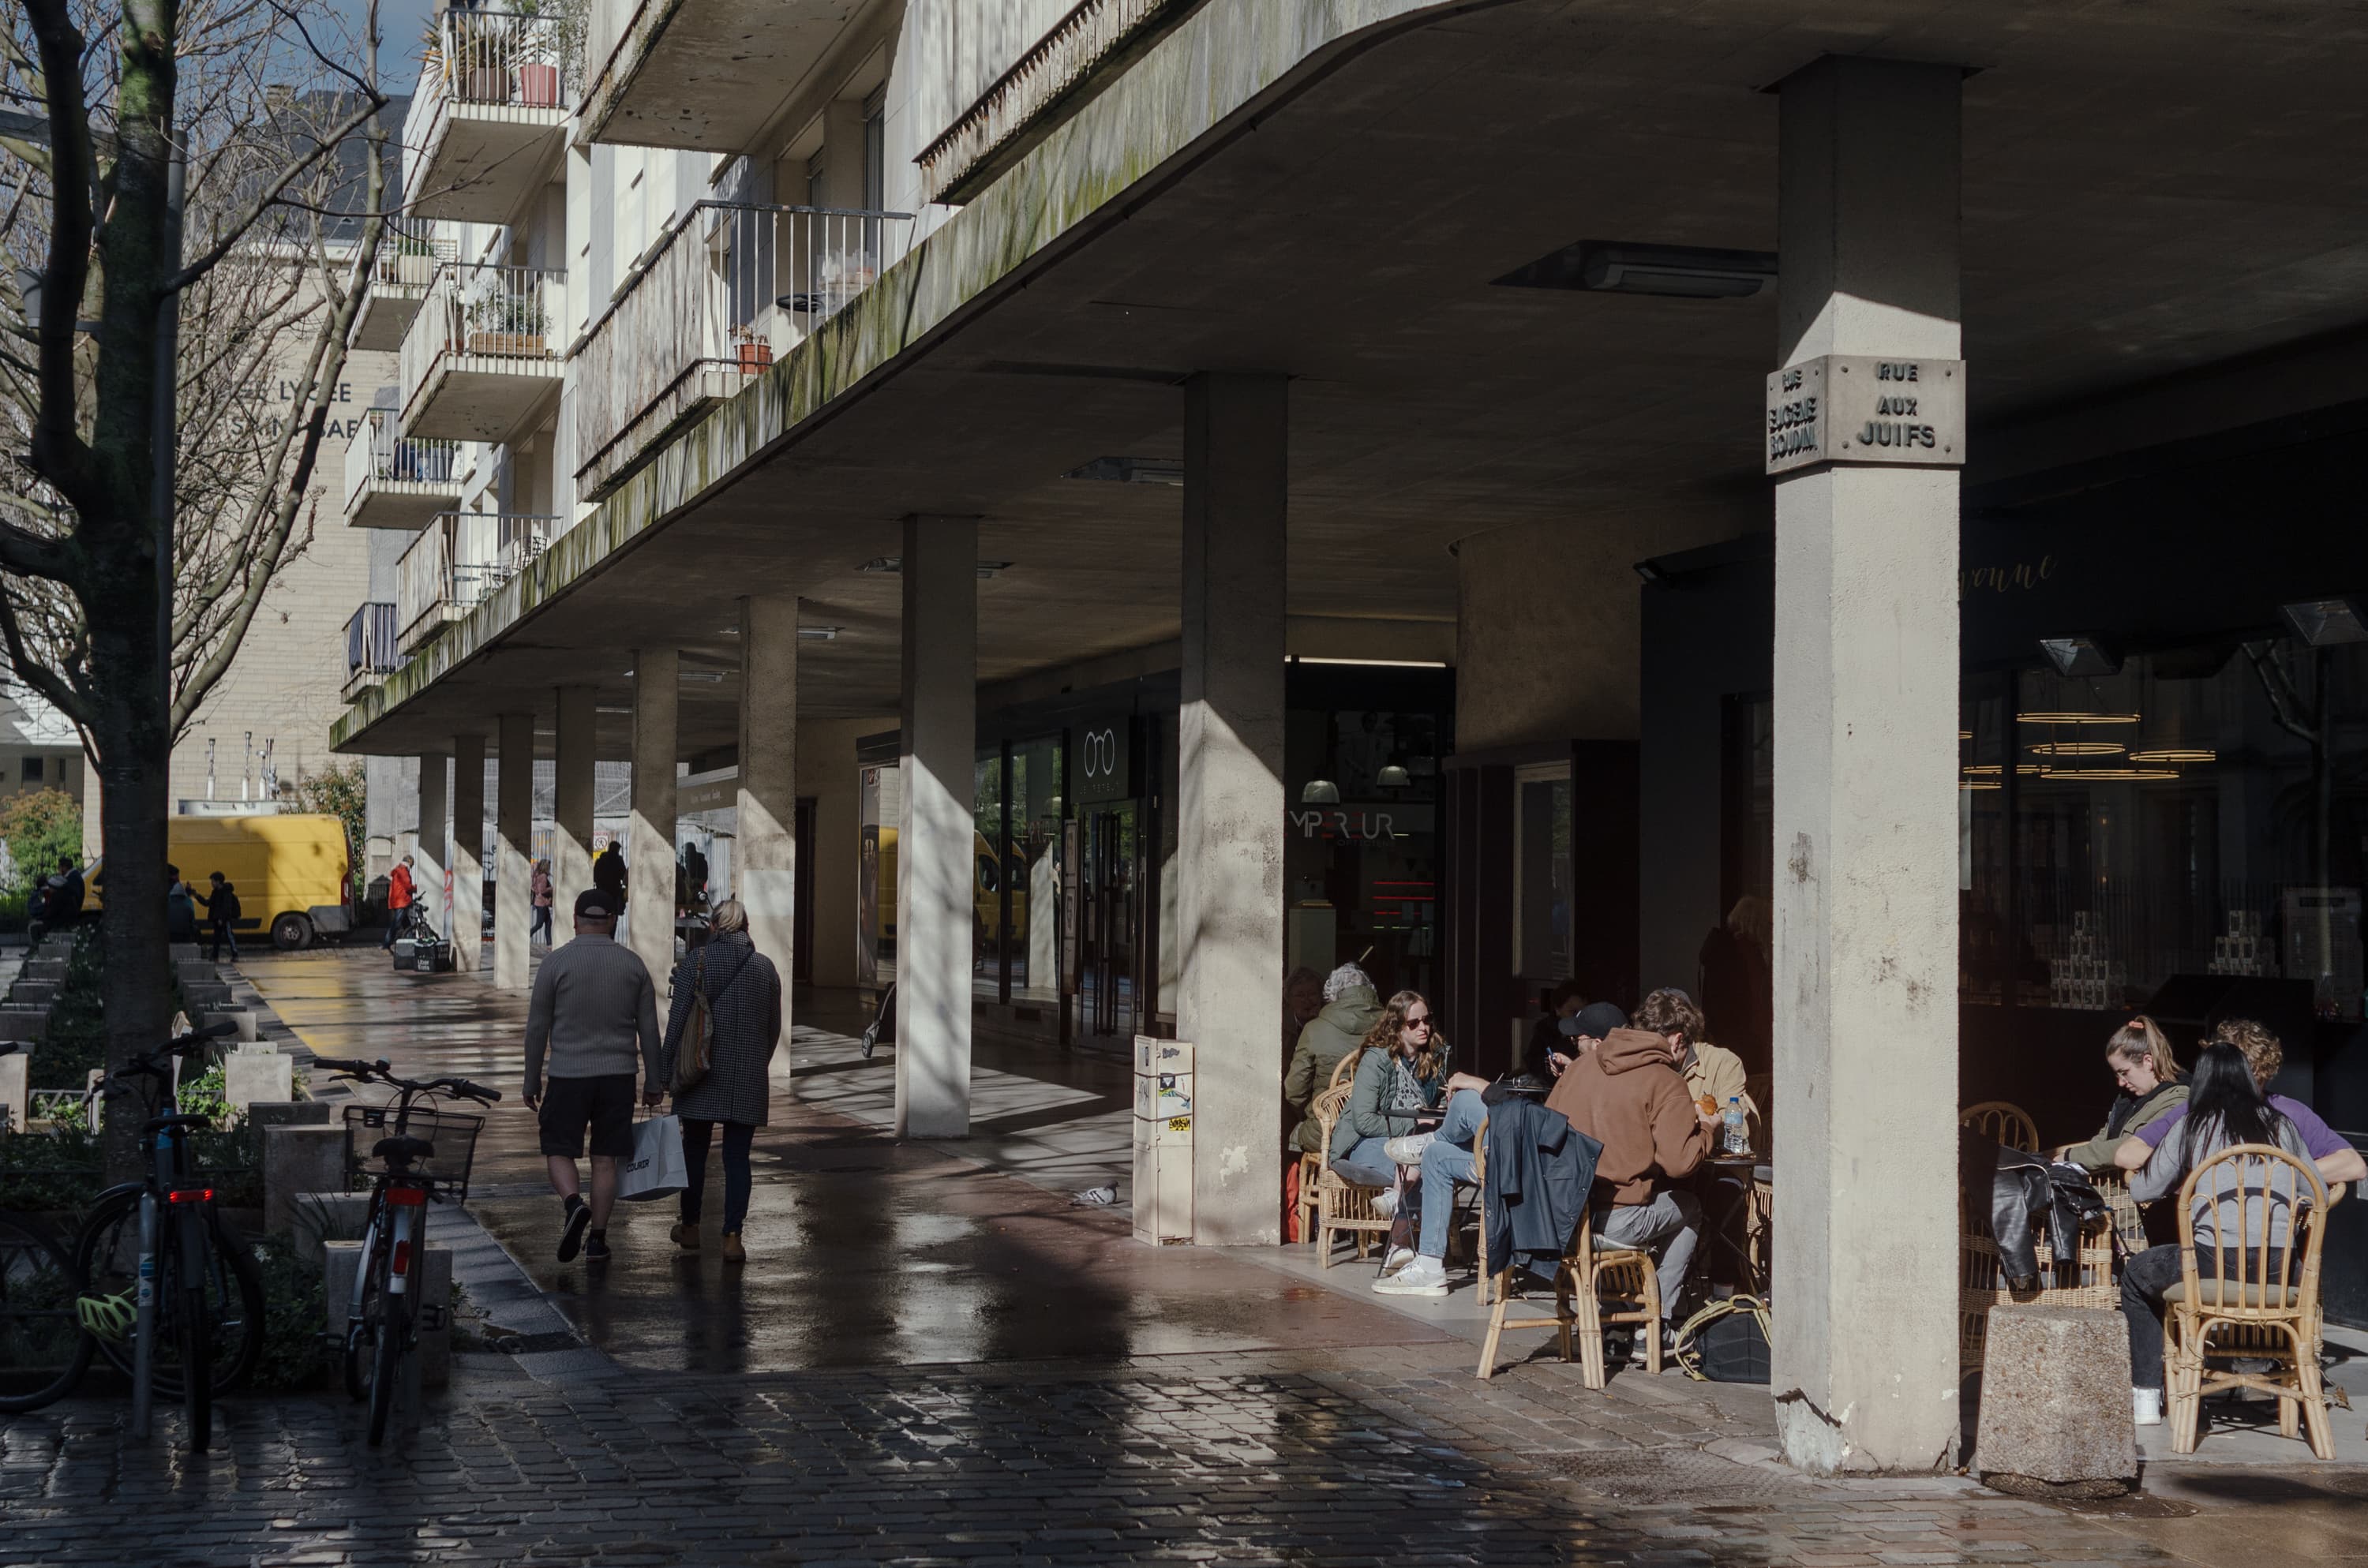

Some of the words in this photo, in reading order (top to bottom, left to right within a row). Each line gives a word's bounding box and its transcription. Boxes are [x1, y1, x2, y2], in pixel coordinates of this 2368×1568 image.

[1782, 369, 1802, 392] RUE
[1876, 362, 1918, 382] RUE
[1769, 397, 1816, 433] EUGENE
[1877, 396, 1918, 416] AUX
[1770, 426, 1817, 460] BOUDIN
[1857, 421, 1935, 448] JUIFS
